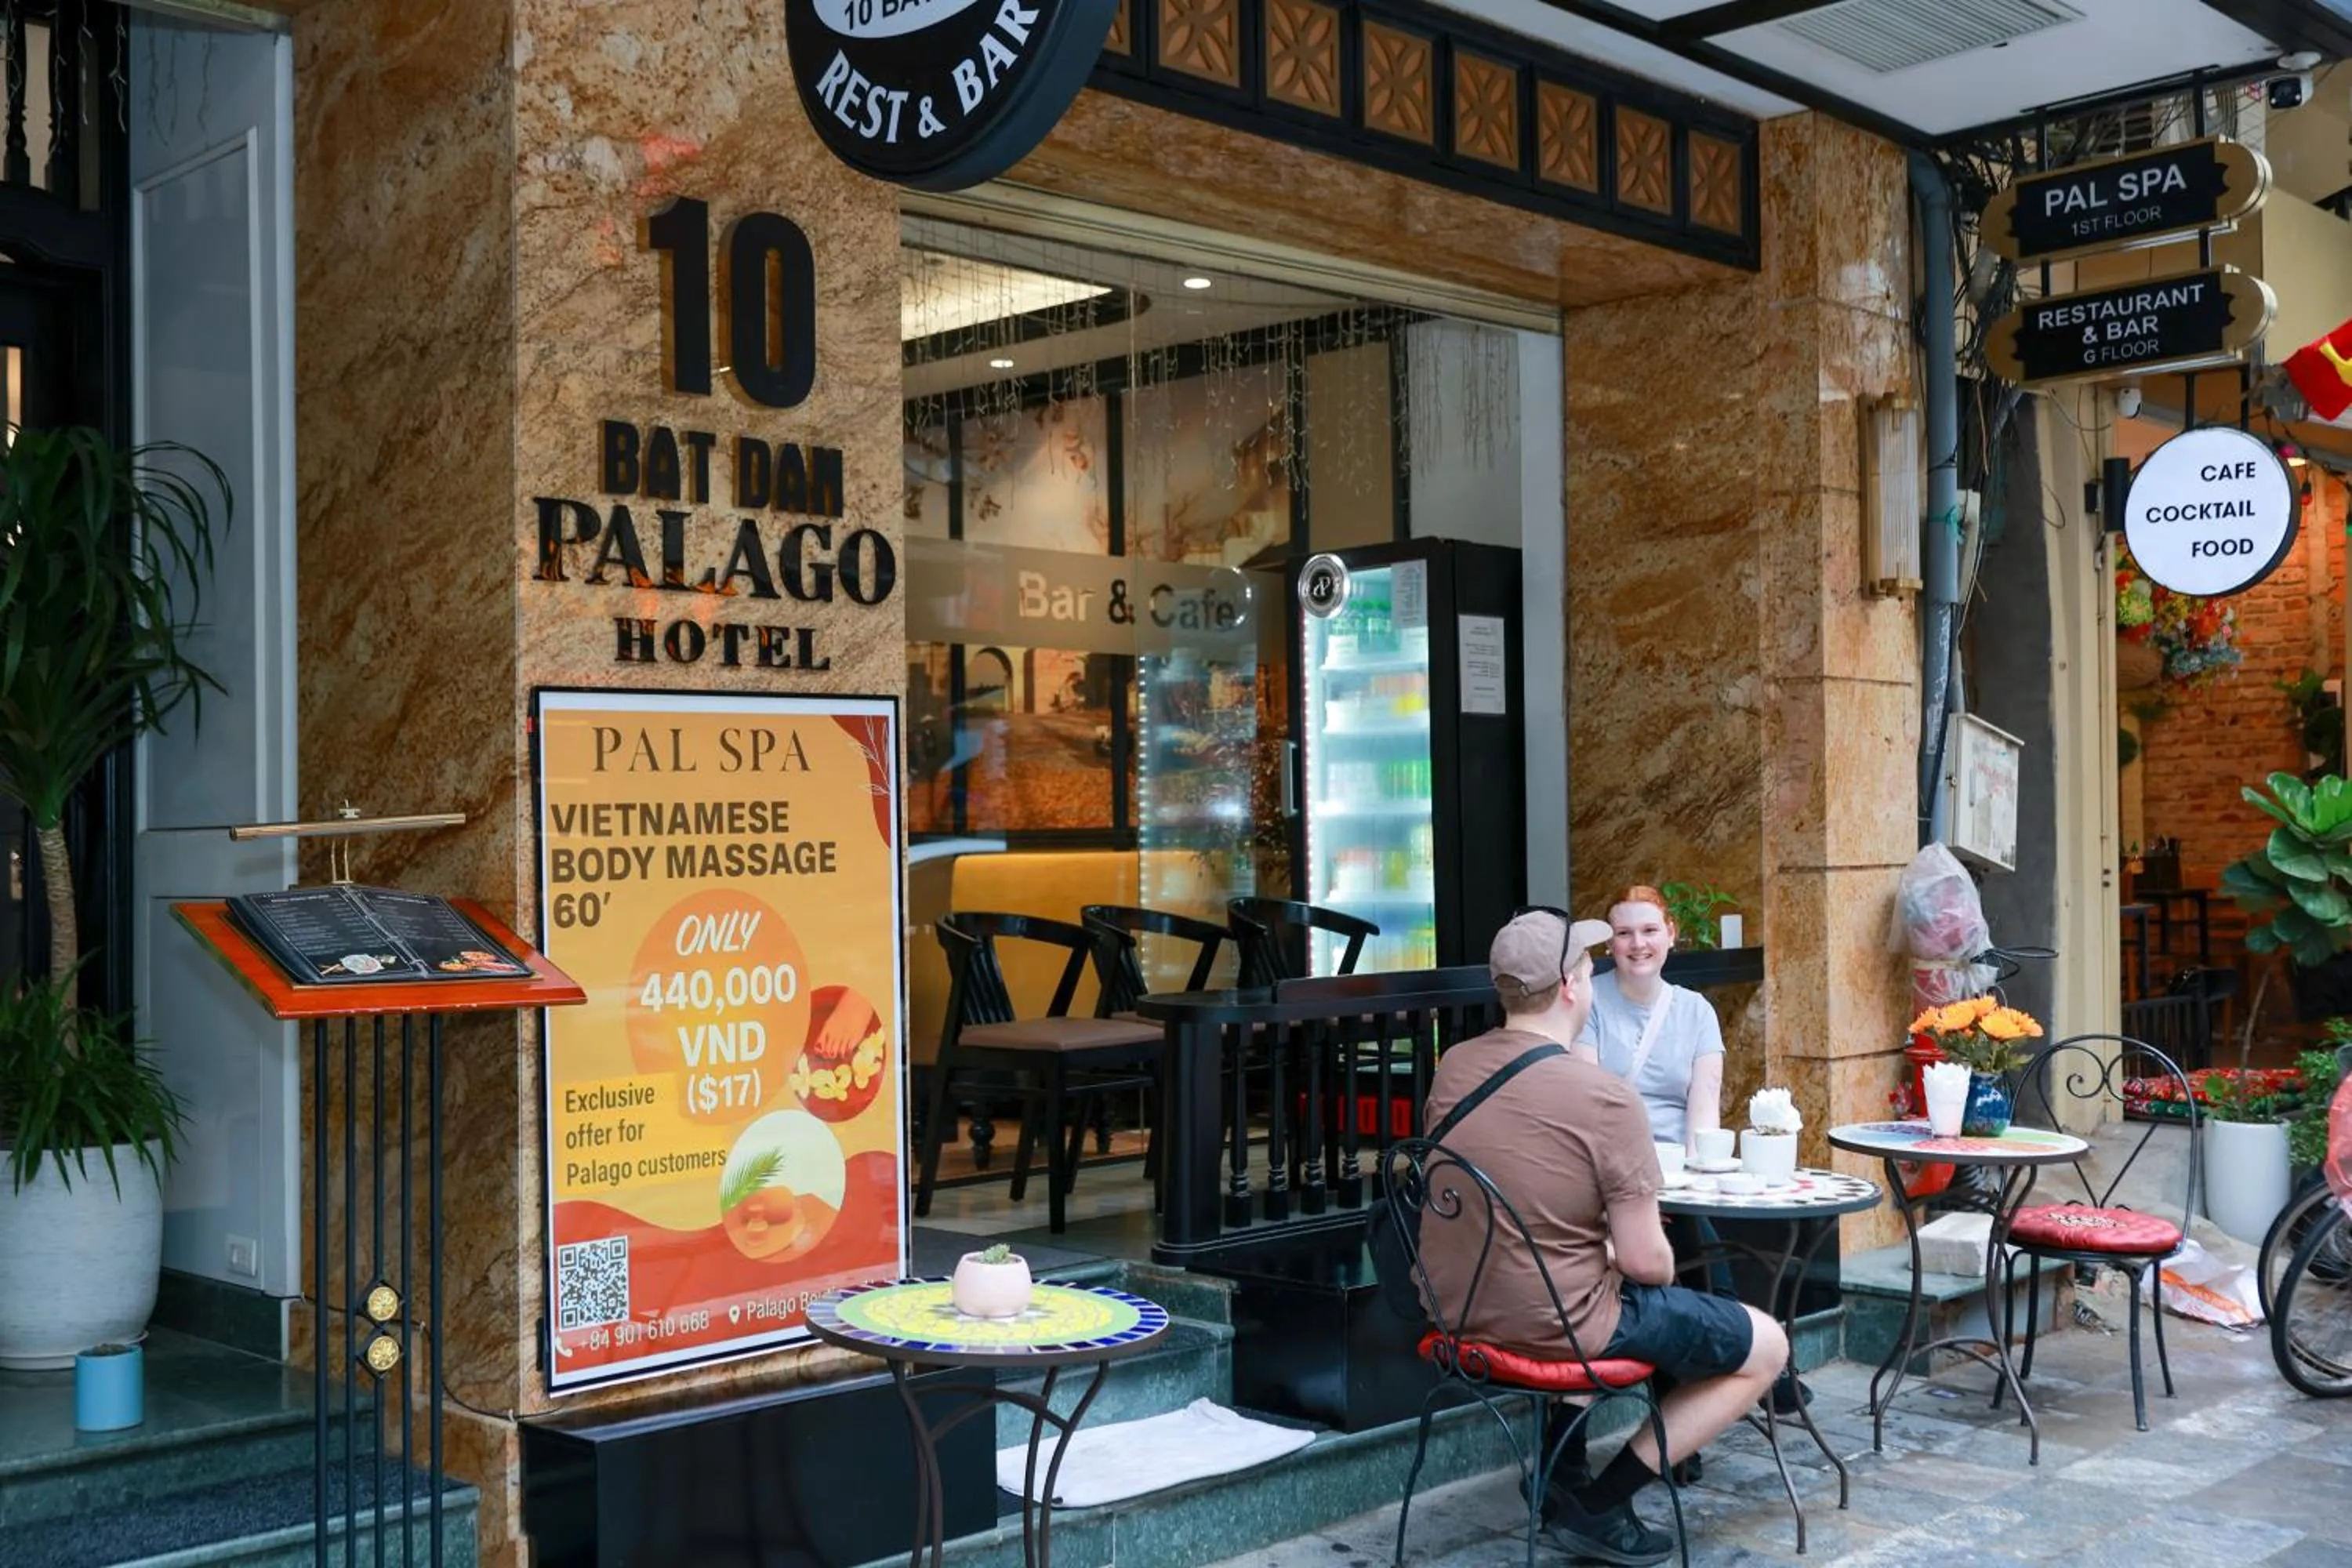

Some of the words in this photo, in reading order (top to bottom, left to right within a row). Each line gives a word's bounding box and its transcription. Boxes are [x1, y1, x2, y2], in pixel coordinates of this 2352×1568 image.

[844, 0, 873, 30] 10
[815, 49, 909, 143] REST
[918, 96, 947, 138] &
[951, 0, 1040, 117] BAR
[2045, 181, 2108, 217] PAL
[2118, 164, 2187, 201] SPA
[2071, 218, 2100, 237] 1ST
[2105, 205, 2161, 228] FLOOR
[637, 196, 816, 409] 10
[2038, 284, 2205, 330] RESTAURANT
[2082, 325, 2098, 345] &
[2107, 316, 2158, 341] BAR
[2084, 349, 2096, 364] G
[2102, 339, 2159, 362] FLOOR
[598, 419, 716, 504] BAT
[732, 436, 844, 517] DAN
[2201, 462, 2256, 481] CAFE
[2146, 500, 2256, 524] COCKTAIL
[532, 496, 896, 605] PALAGO
[2191, 539, 2254, 557] FOOD
[1018, 570, 1096, 622] Bar
[1108, 579, 1135, 625] &
[1149, 583, 1236, 630] Cafe
[614, 617, 831, 671] HOTEL
[592, 727, 697, 772] PAL
[719, 728, 811, 772] SPA
[550, 801, 789, 837] VIETNAMESE
[551, 845, 655, 883] BODY
[666, 841, 837, 879] MASSAGE
[676, 910, 761, 956] ONLY
[640, 964, 797, 1015] 440,000
[677, 1021, 766, 1068] VND
[565, 1082, 655, 1113] Exclusive
[686, 1068, 762, 1114] ($17)
[565, 1121, 613, 1149] offer
[617, 1118, 645, 1143] for
[567, 1160, 632, 1187] Palago
[637, 1149, 727, 1177] customers
[746, 1296, 797, 1321] Palago
[580, 1329, 610, 1351] +84
[615, 1322, 642, 1348] 901
[648, 1317, 675, 1340] 610
